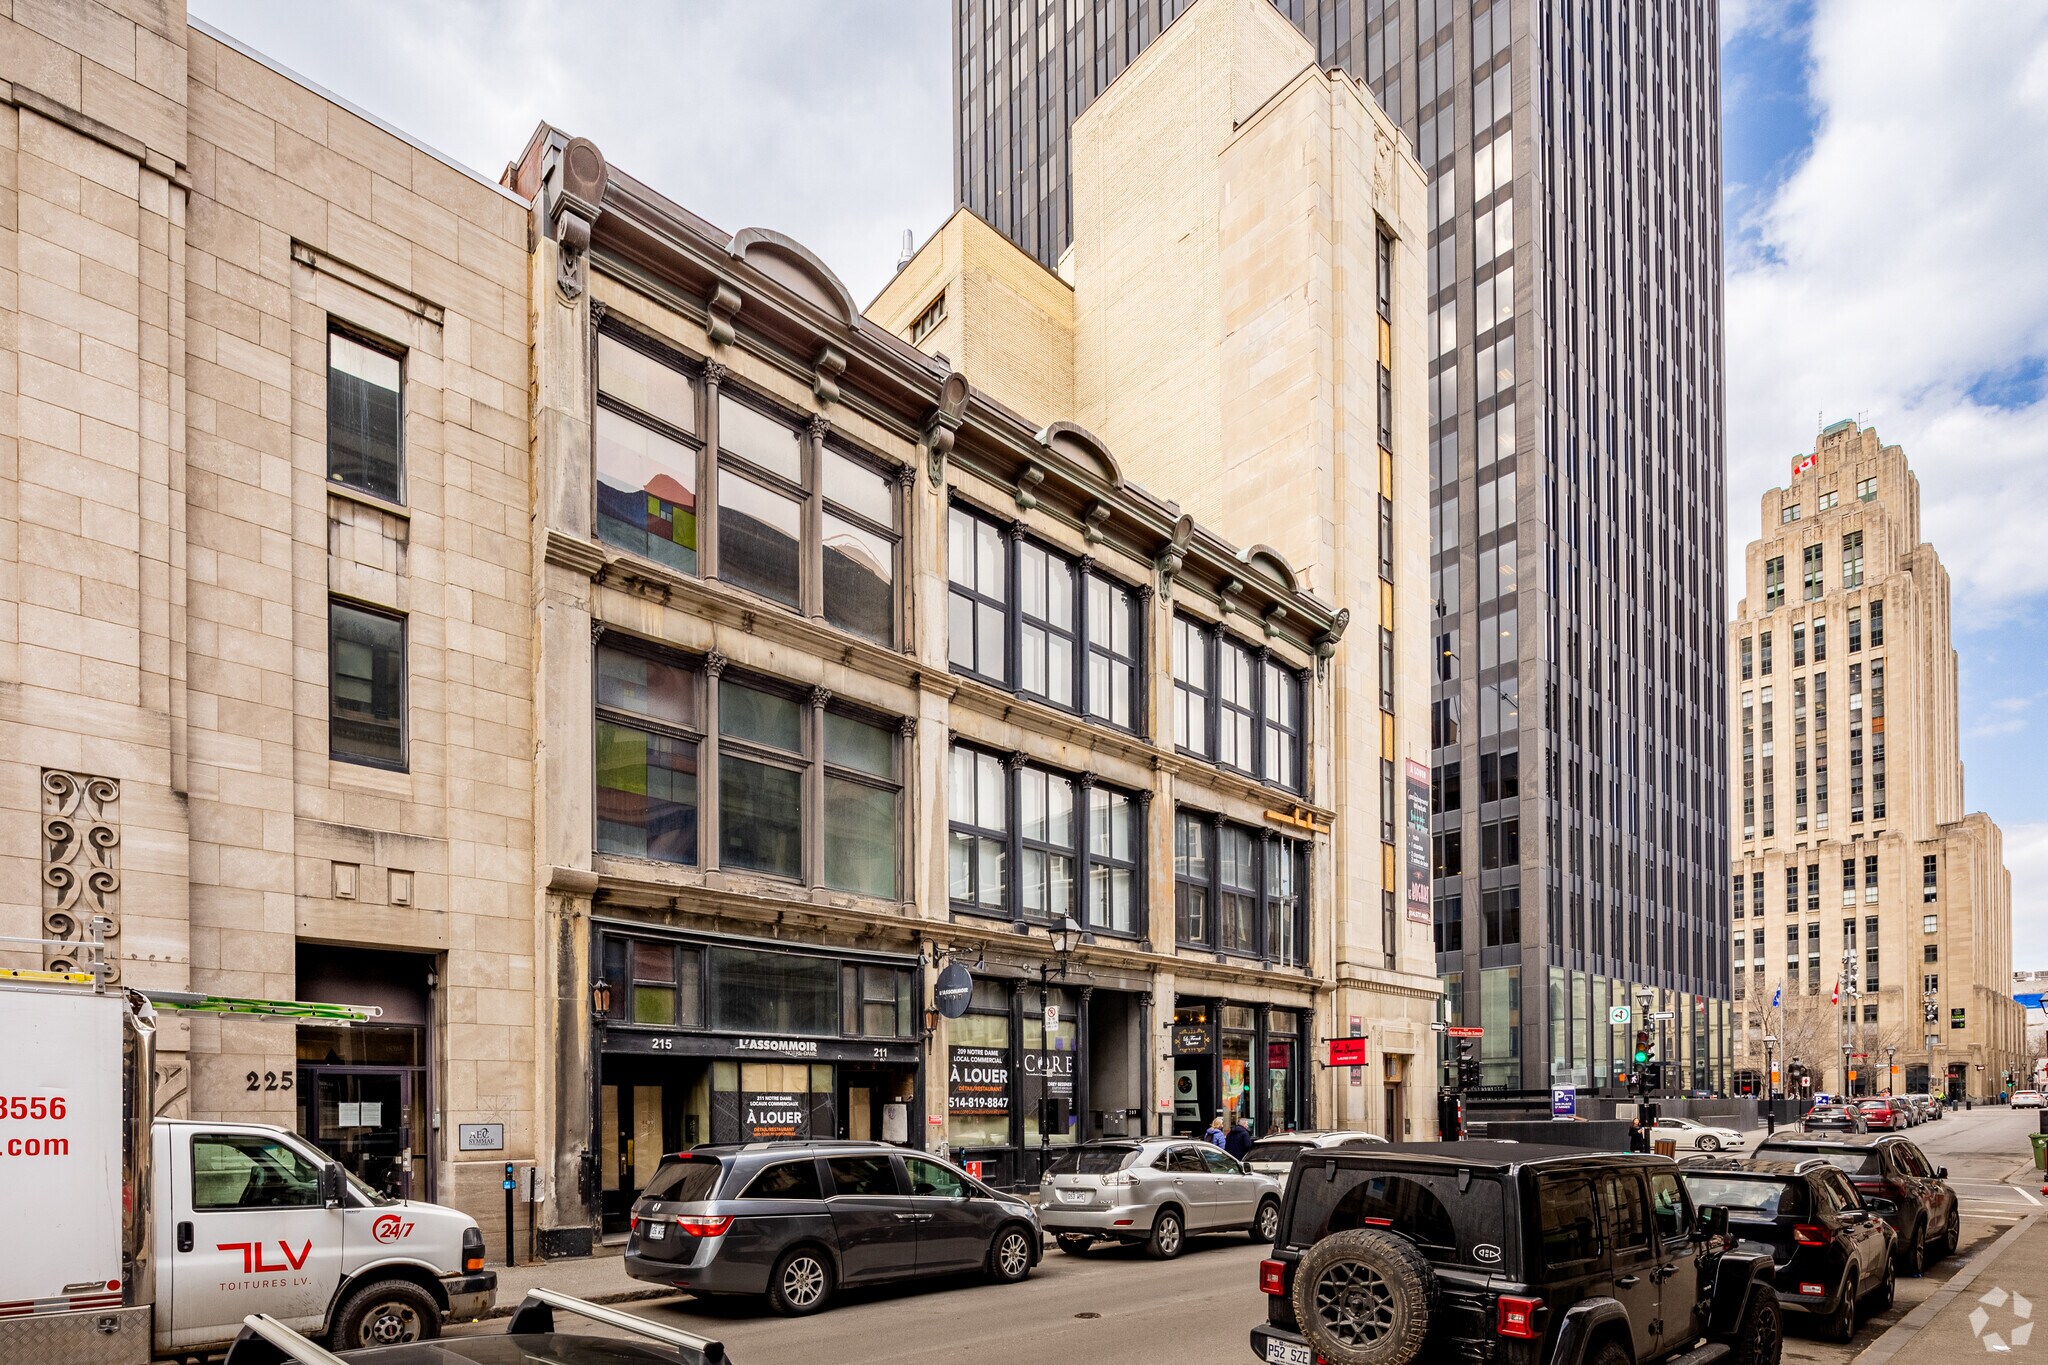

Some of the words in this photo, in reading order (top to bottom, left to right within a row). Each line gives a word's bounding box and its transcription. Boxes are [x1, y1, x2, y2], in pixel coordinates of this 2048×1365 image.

[651, 1038, 672, 1049] 215
[738, 1039, 817, 1051] L'ASSOMMOIR
[873, 1047, 888, 1057] 211
[970, 1056, 1002, 1064] COMMERCIAL
[950, 1064, 960, 1082] À
[964, 1068, 1008, 1084] LOUER
[246, 1071, 294, 1091] 225
[1555, 1090, 1565, 1102] P
[949, 1097, 1009, 1108] 514-819-8847
[746, 1108, 757, 1124] À
[760, 1111, 802, 1124] LOUER
[380, 1216, 415, 1240] 24/7
[219, 1278, 287, 1291] TOITURES
[1268, 1343, 1286, 1360] P52
[1290, 1349, 1309, 1365] SZE
